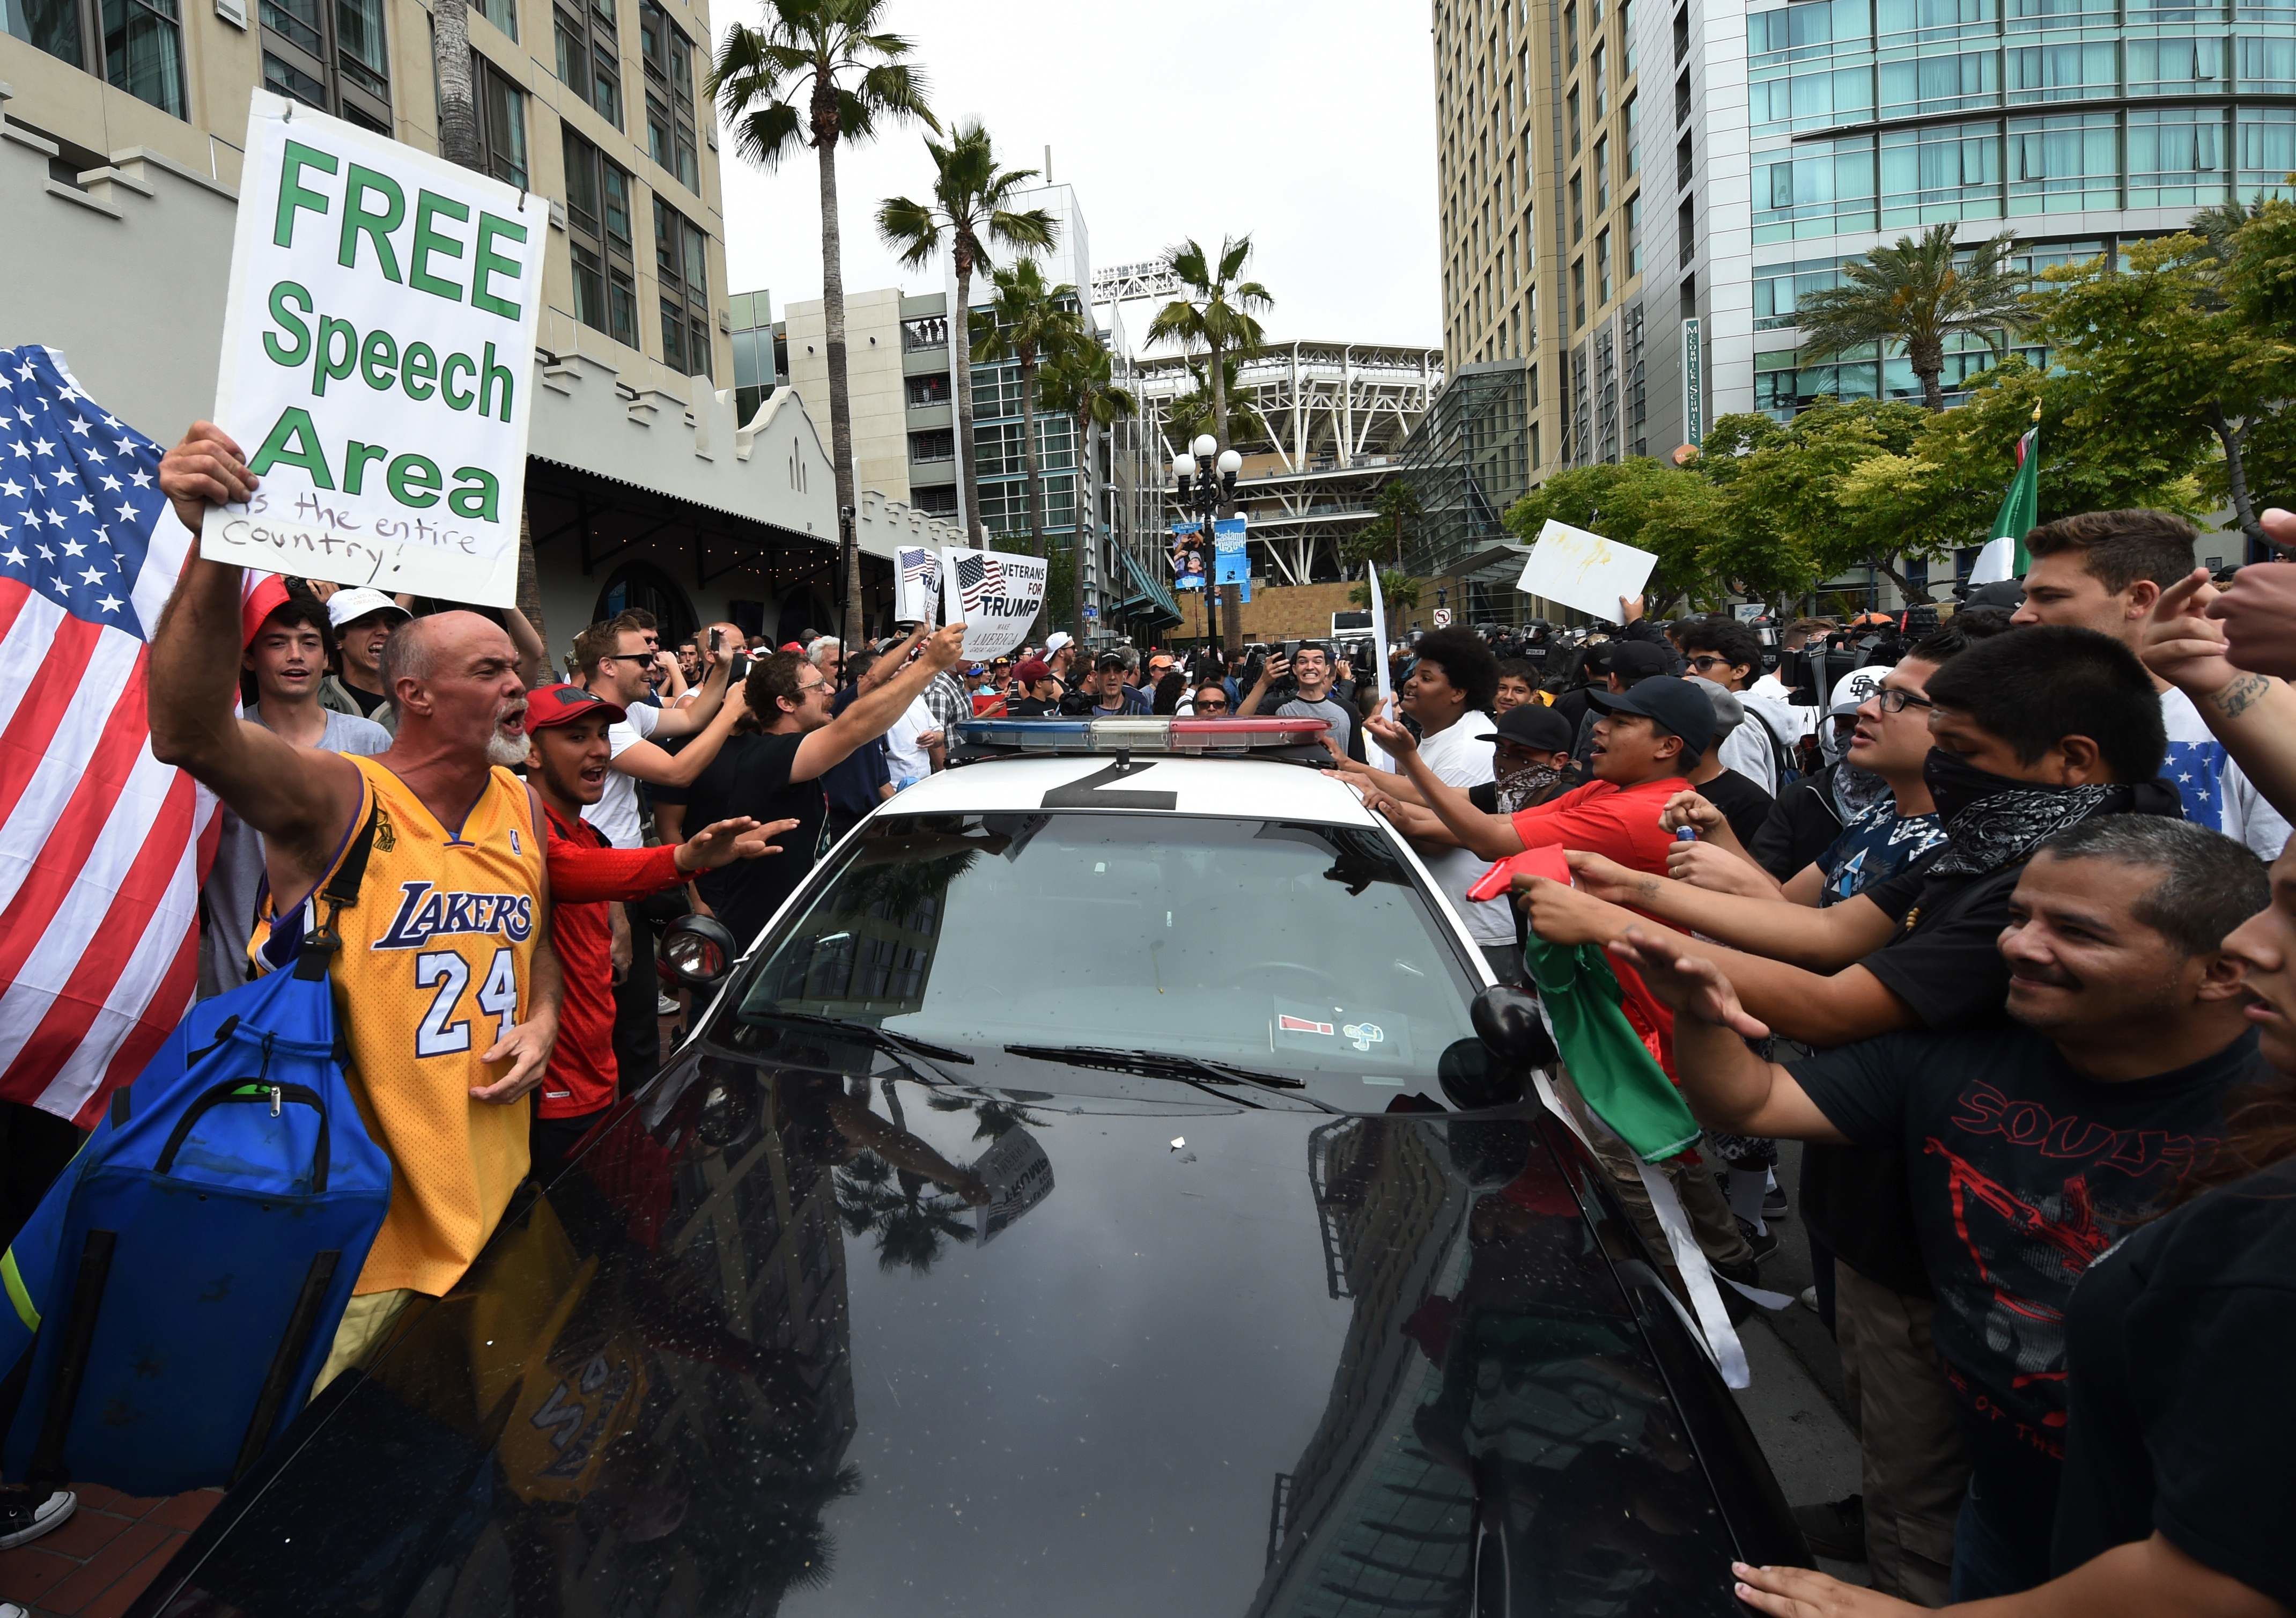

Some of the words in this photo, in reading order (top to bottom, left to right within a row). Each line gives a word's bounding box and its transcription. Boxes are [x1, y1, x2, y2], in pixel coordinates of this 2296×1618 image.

[273, 139, 528, 322] FREE
[262, 281, 514, 423] Speech
[247, 406, 500, 524] Area
[293, 491, 361, 530] the
[375, 518, 477, 555] entire
[1001, 562, 1045, 581] VETERANS
[1027, 582, 1043, 596] FOR
[969, 633, 1019, 646] AMERICA
[979, 595, 1039, 617] TRUMP
[370, 880, 533, 951] LAKERS
[415, 946, 518, 1059] 24
